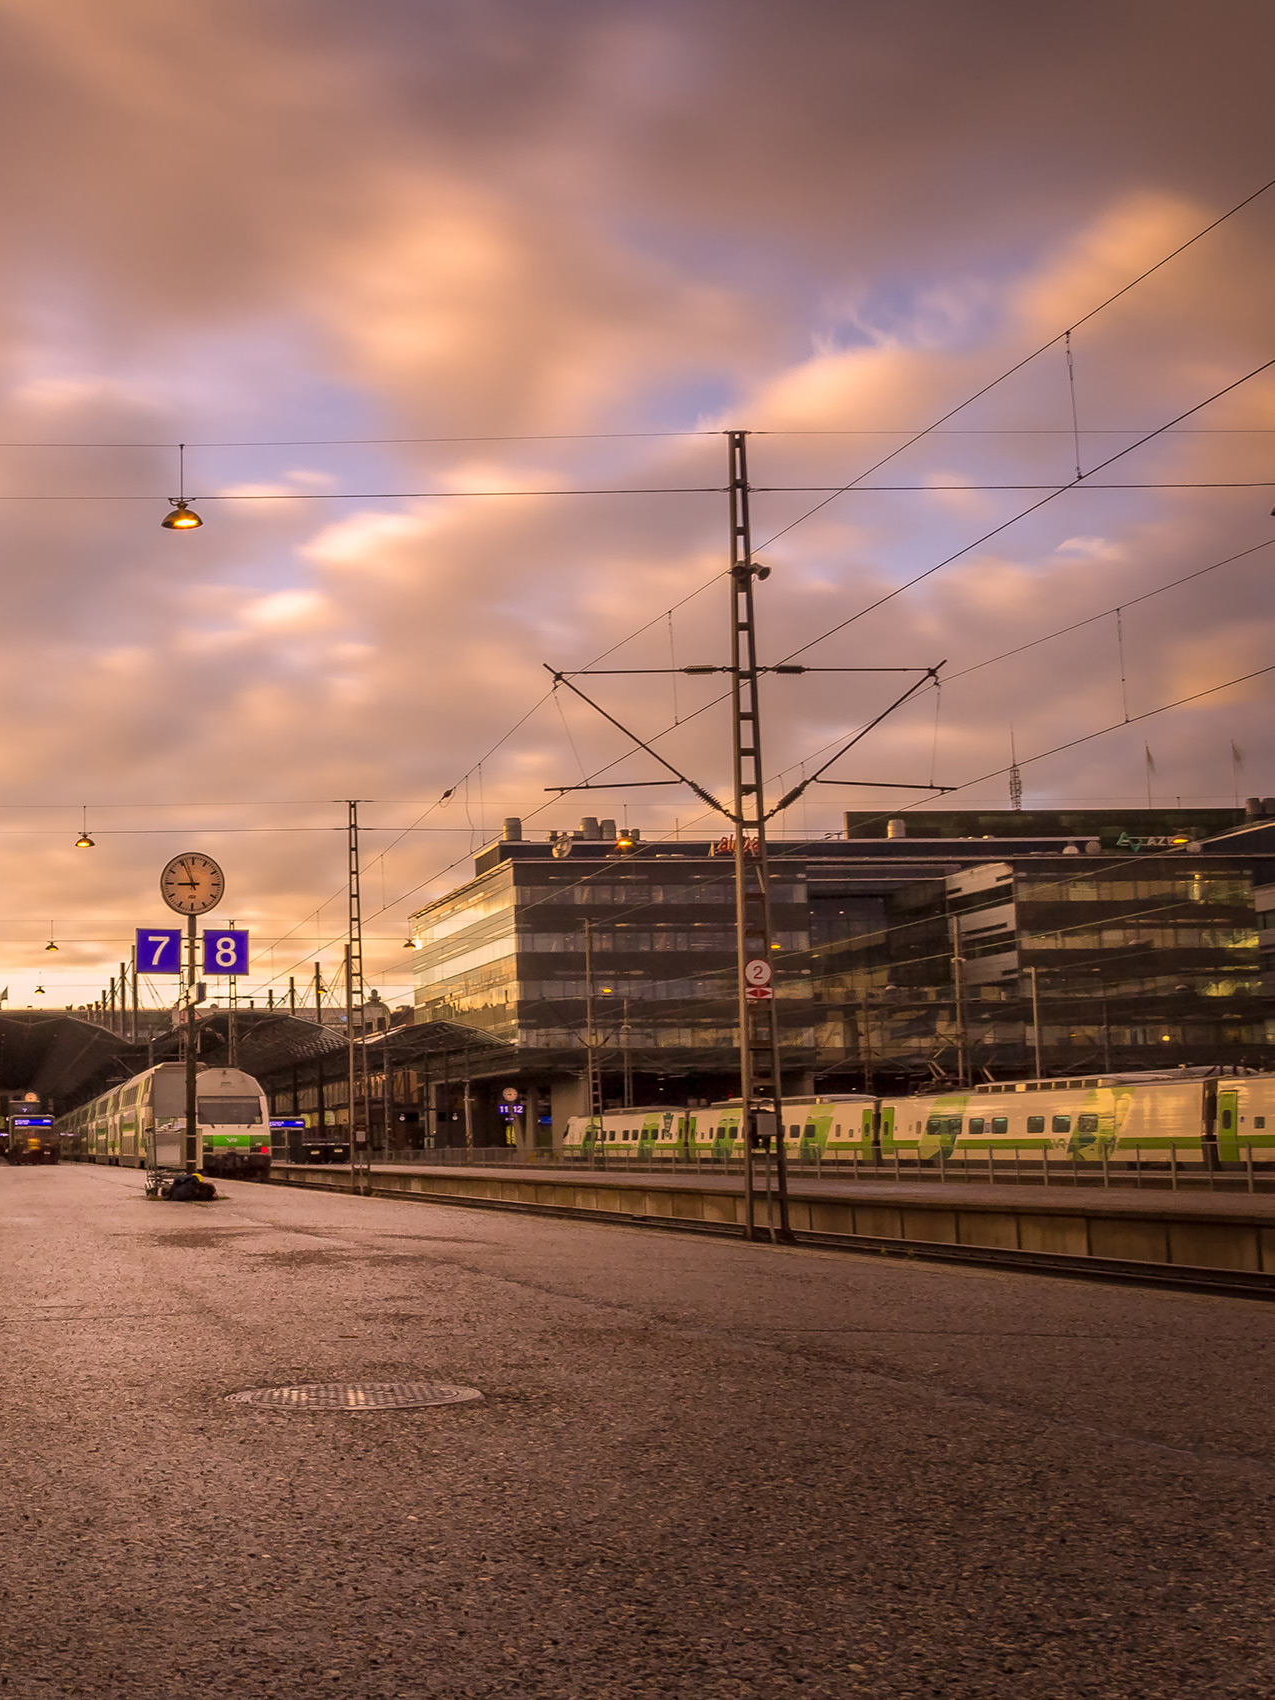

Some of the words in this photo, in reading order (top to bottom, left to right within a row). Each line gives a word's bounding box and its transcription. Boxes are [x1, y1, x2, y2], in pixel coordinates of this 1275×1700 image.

[148, 935, 170, 966] 7
[215, 937, 237, 967] 8
[753, 965, 764, 979] 2
[499, 1105, 509, 1113] 11
[512, 1105, 524, 1114] 12
